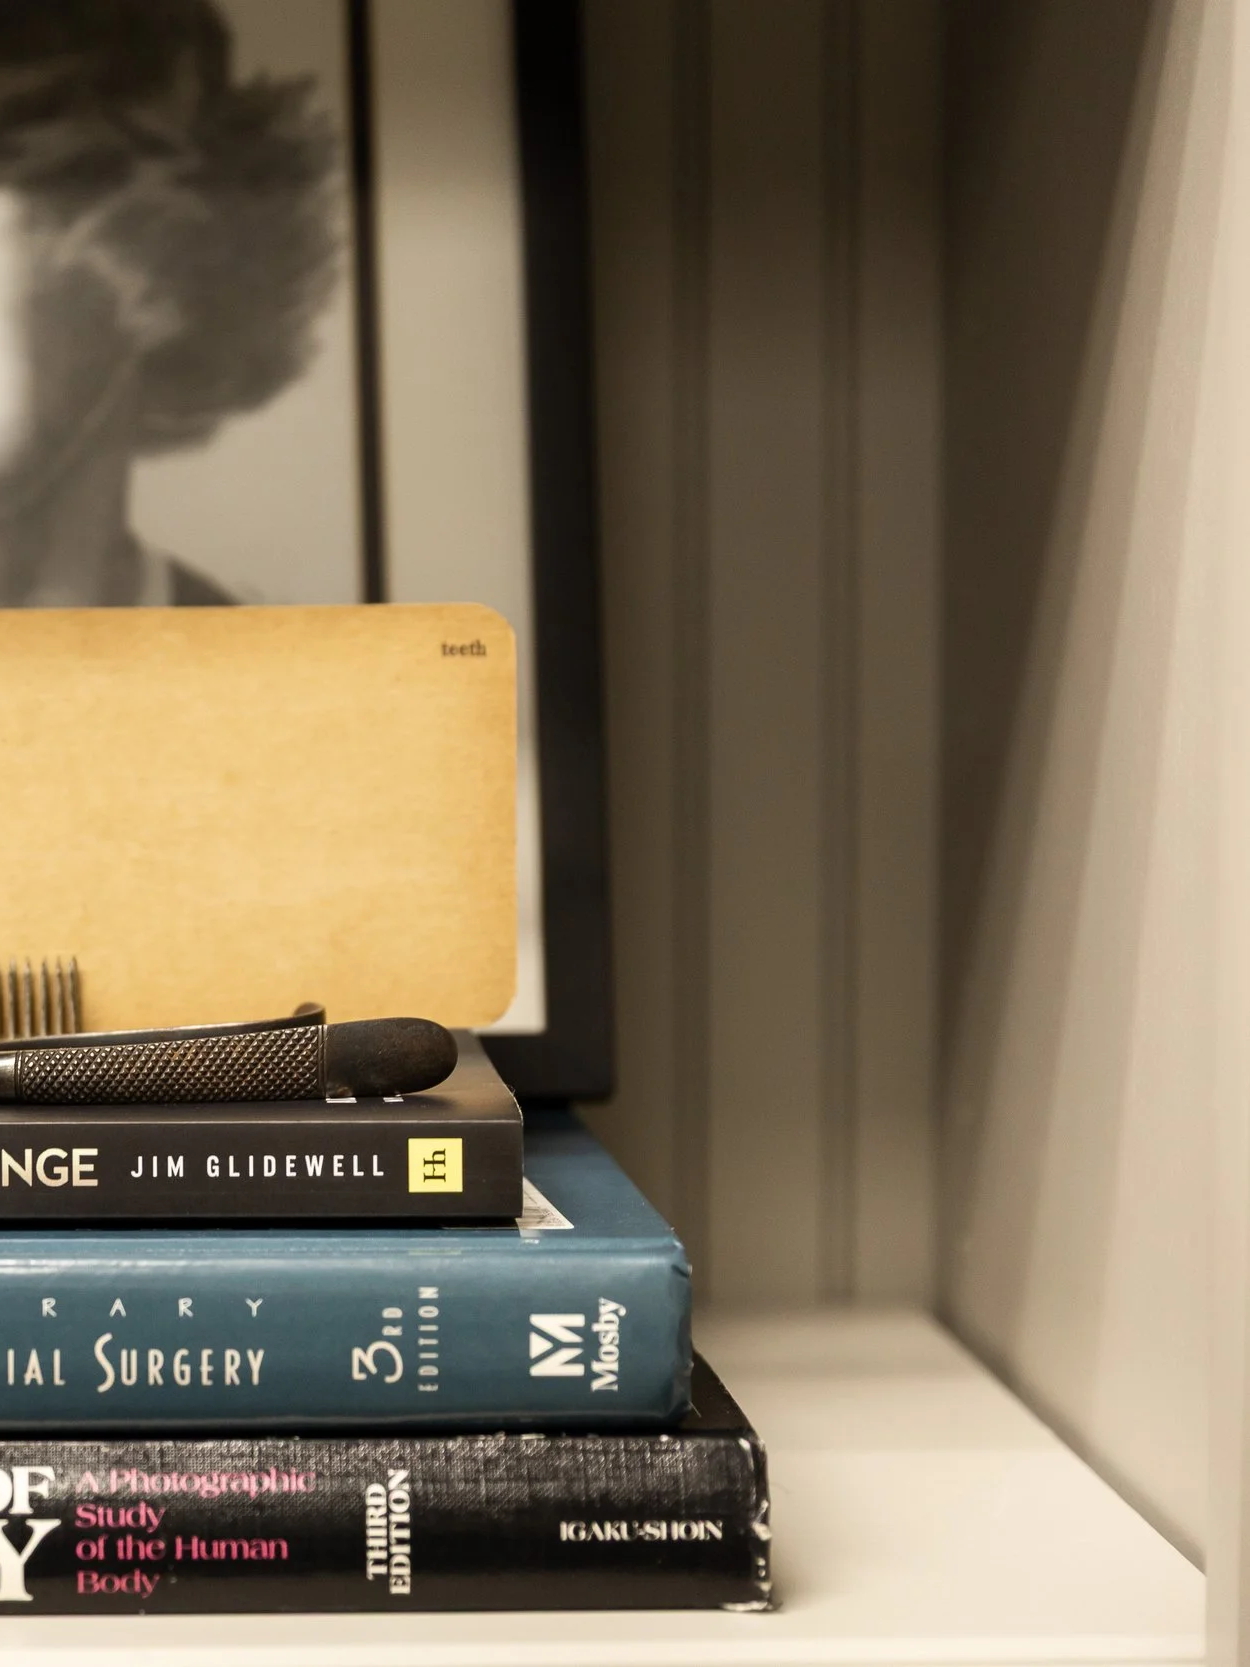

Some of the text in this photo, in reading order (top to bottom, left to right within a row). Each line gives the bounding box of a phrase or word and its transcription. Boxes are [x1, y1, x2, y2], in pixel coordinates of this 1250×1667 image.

[441, 639, 487, 656] teeth
[130, 1153, 385, 1179] JIM GLIDEWELL
[418, 1286, 440, 1393] EDITION
[591, 1297, 626, 1393] Mosby
[75, 1468, 316, 1499] A Photographic
[75, 1502, 166, 1533] Study
[365, 1483, 388, 1581] THIRD
[388, 1468, 411, 1595] EDITION
[559, 1520, 724, 1542] IGAKU-SHOIN
[75, 1536, 288, 1560] of the Human
[76, 1569, 160, 1598] Body
